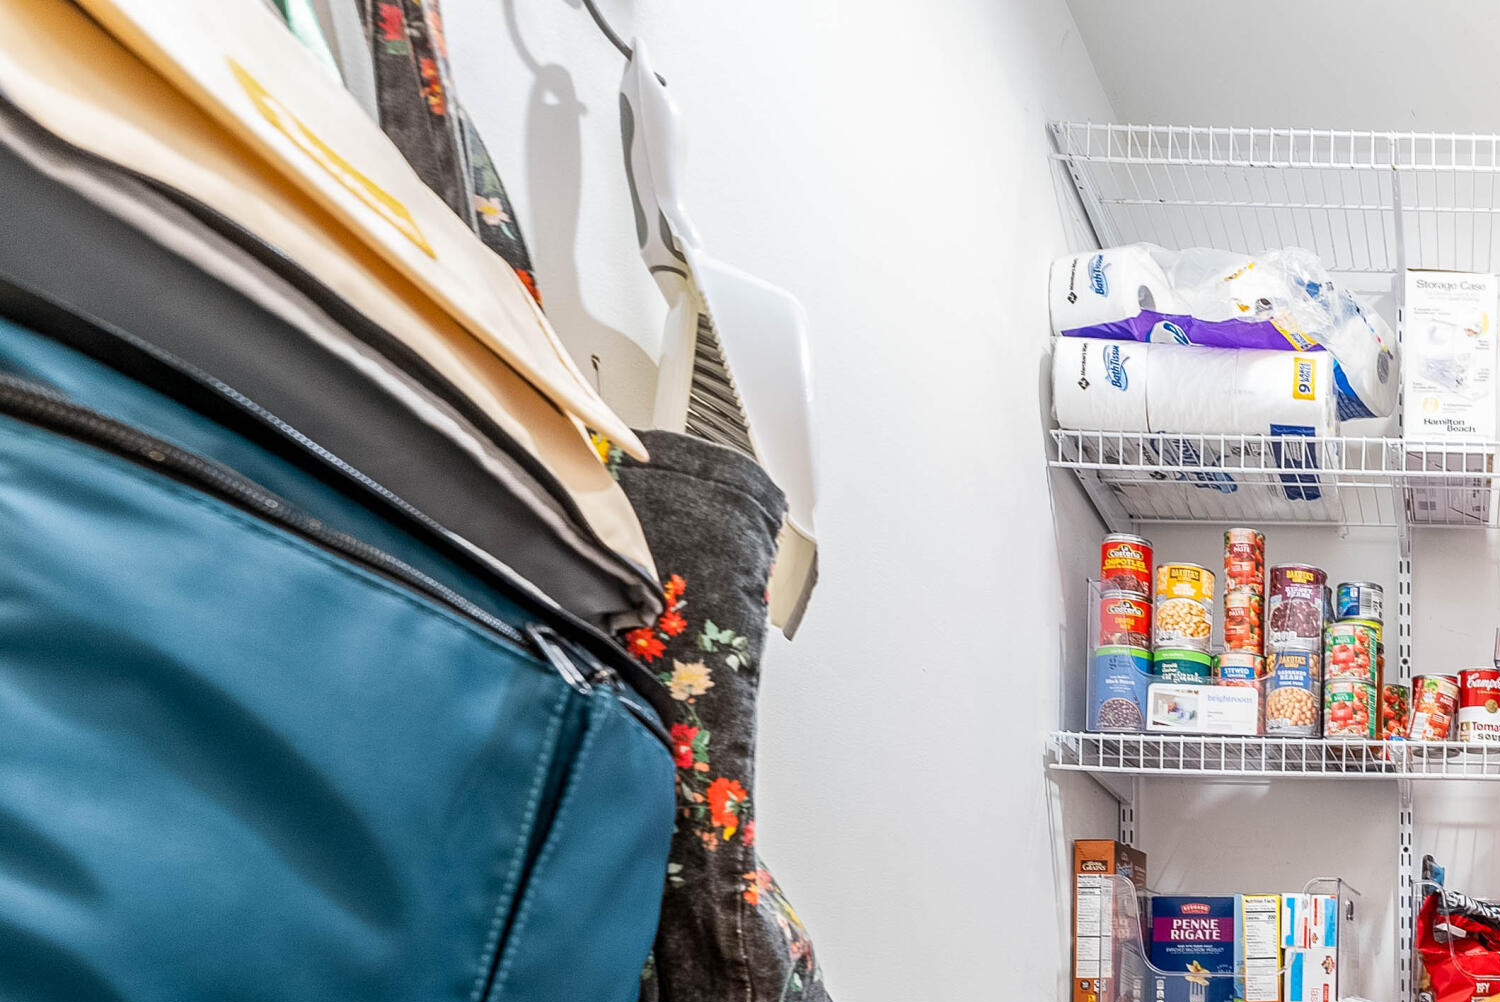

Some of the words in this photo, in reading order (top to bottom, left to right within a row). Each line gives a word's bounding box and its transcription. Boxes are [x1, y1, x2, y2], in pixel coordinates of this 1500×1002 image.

[1416, 279, 1457, 291] Storage
[1460, 280, 1486, 291] Case
[1299, 383, 1311, 393] 9
[1423, 417, 1465, 426] Hamilton
[1446, 424, 1477, 433] Beach
[1172, 918, 1219, 929] PENNE
[1170, 930, 1221, 940] RIGATE
